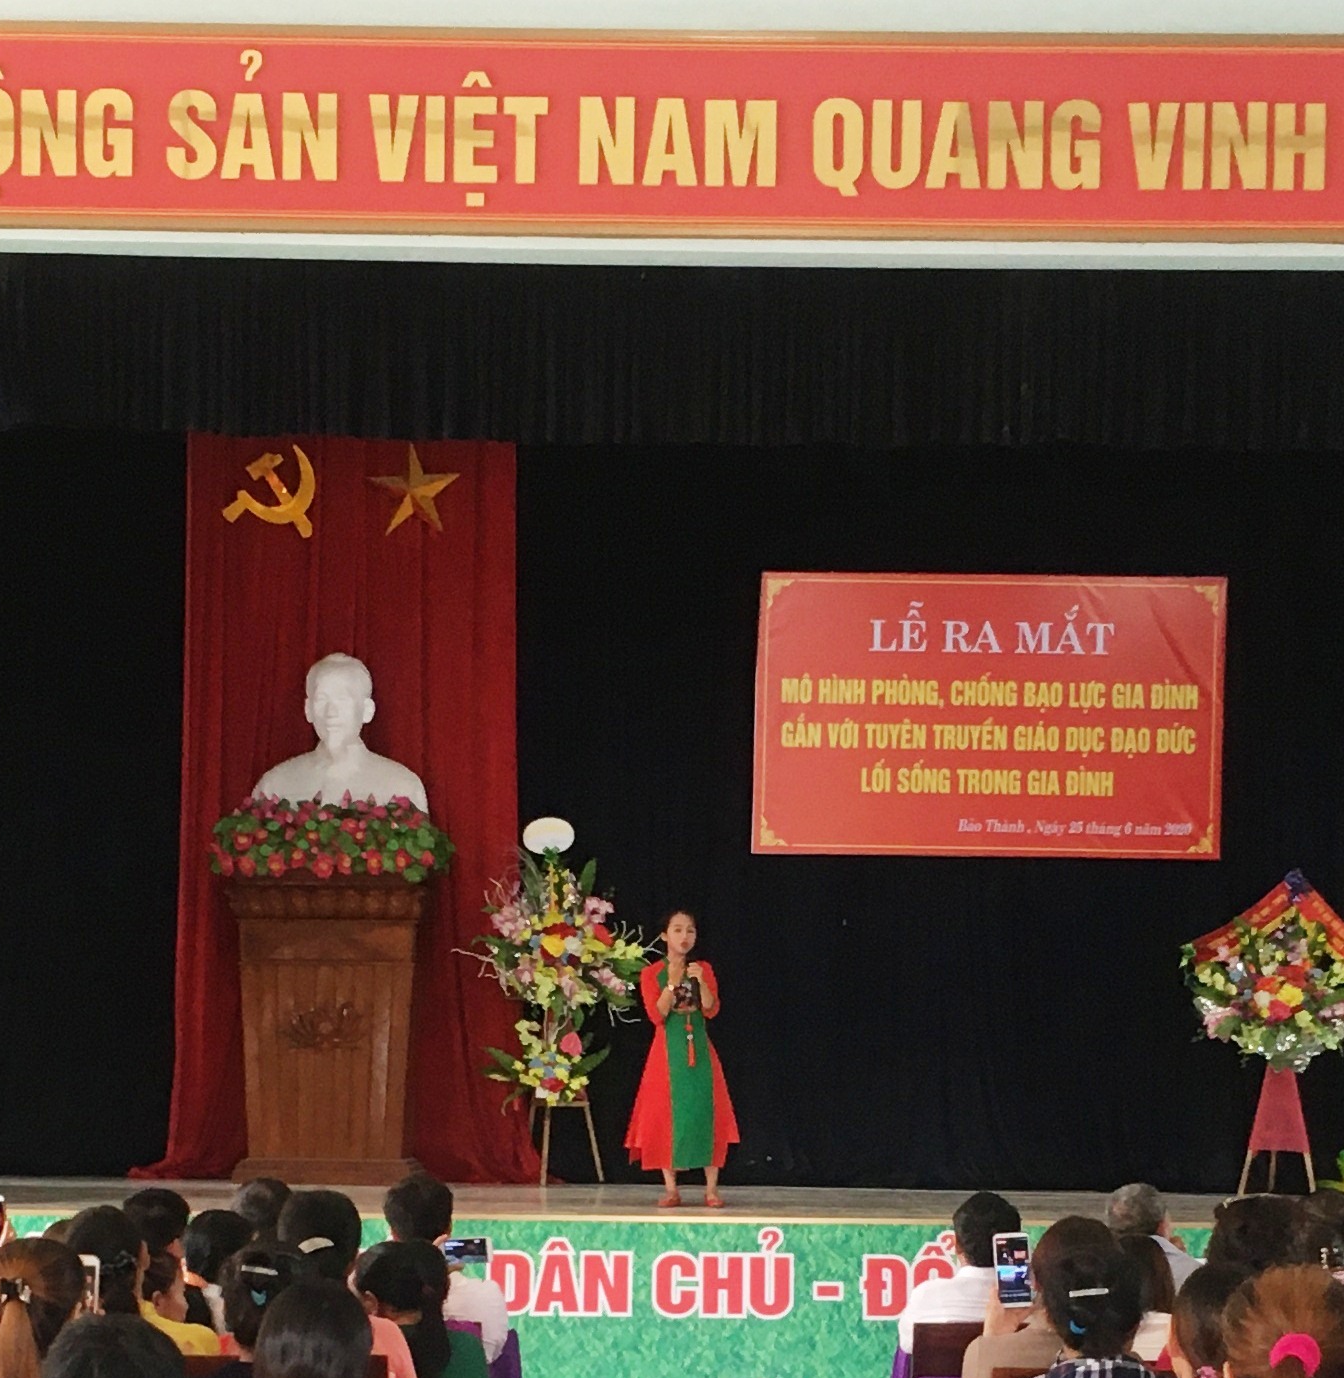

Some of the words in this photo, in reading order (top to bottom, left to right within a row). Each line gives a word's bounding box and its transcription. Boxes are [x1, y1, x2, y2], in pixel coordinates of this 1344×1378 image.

[166, 50, 338, 181] SẢN
[368, 71, 549, 207] VIỆT
[578, 96, 776, 188] NAM
[812, 97, 1101, 197] QUANG
[1127, 99, 1326, 191] VINH
[868, 601, 927, 652] LỄ
[941, 620, 1002, 653] RA
[1014, 604, 1115, 655] MẮT
[781, 673, 813, 704] MÔ
[818, 673, 866, 704] HÌNH
[871, 673, 944, 709] PHÒNG,
[950, 672, 1018, 707] CHỐNG
[1023, 681, 1063, 713] BẠO
[1068, 680, 1106, 714] LỰC
[1111, 683, 1145, 709] GIA
[1150, 678, 1199, 710] ĐÌNH
[781, 712, 822, 748] GẮN
[827, 717, 859, 749] VỚI
[865, 718, 927, 750] TUYÊN
[1013, 720, 1060, 752] GIÁO
[1065, 725, 1105, 758] DỤC
[1110, 727, 1150, 759] ĐẠO
[1156, 722, 1196, 755] ĐỨC
[861, 758, 891, 793] LỐI
[897, 758, 951, 794] SỐNG
[956, 768, 1022, 795] TRONG
[1027, 770, 1060, 797] GIA
[1065, 765, 1114, 797] ĐÌNH
[487, 1237, 635, 1317] DÂN
[652, 1227, 795, 1320] CHỦ
[813, 1279, 845, 1302] -
